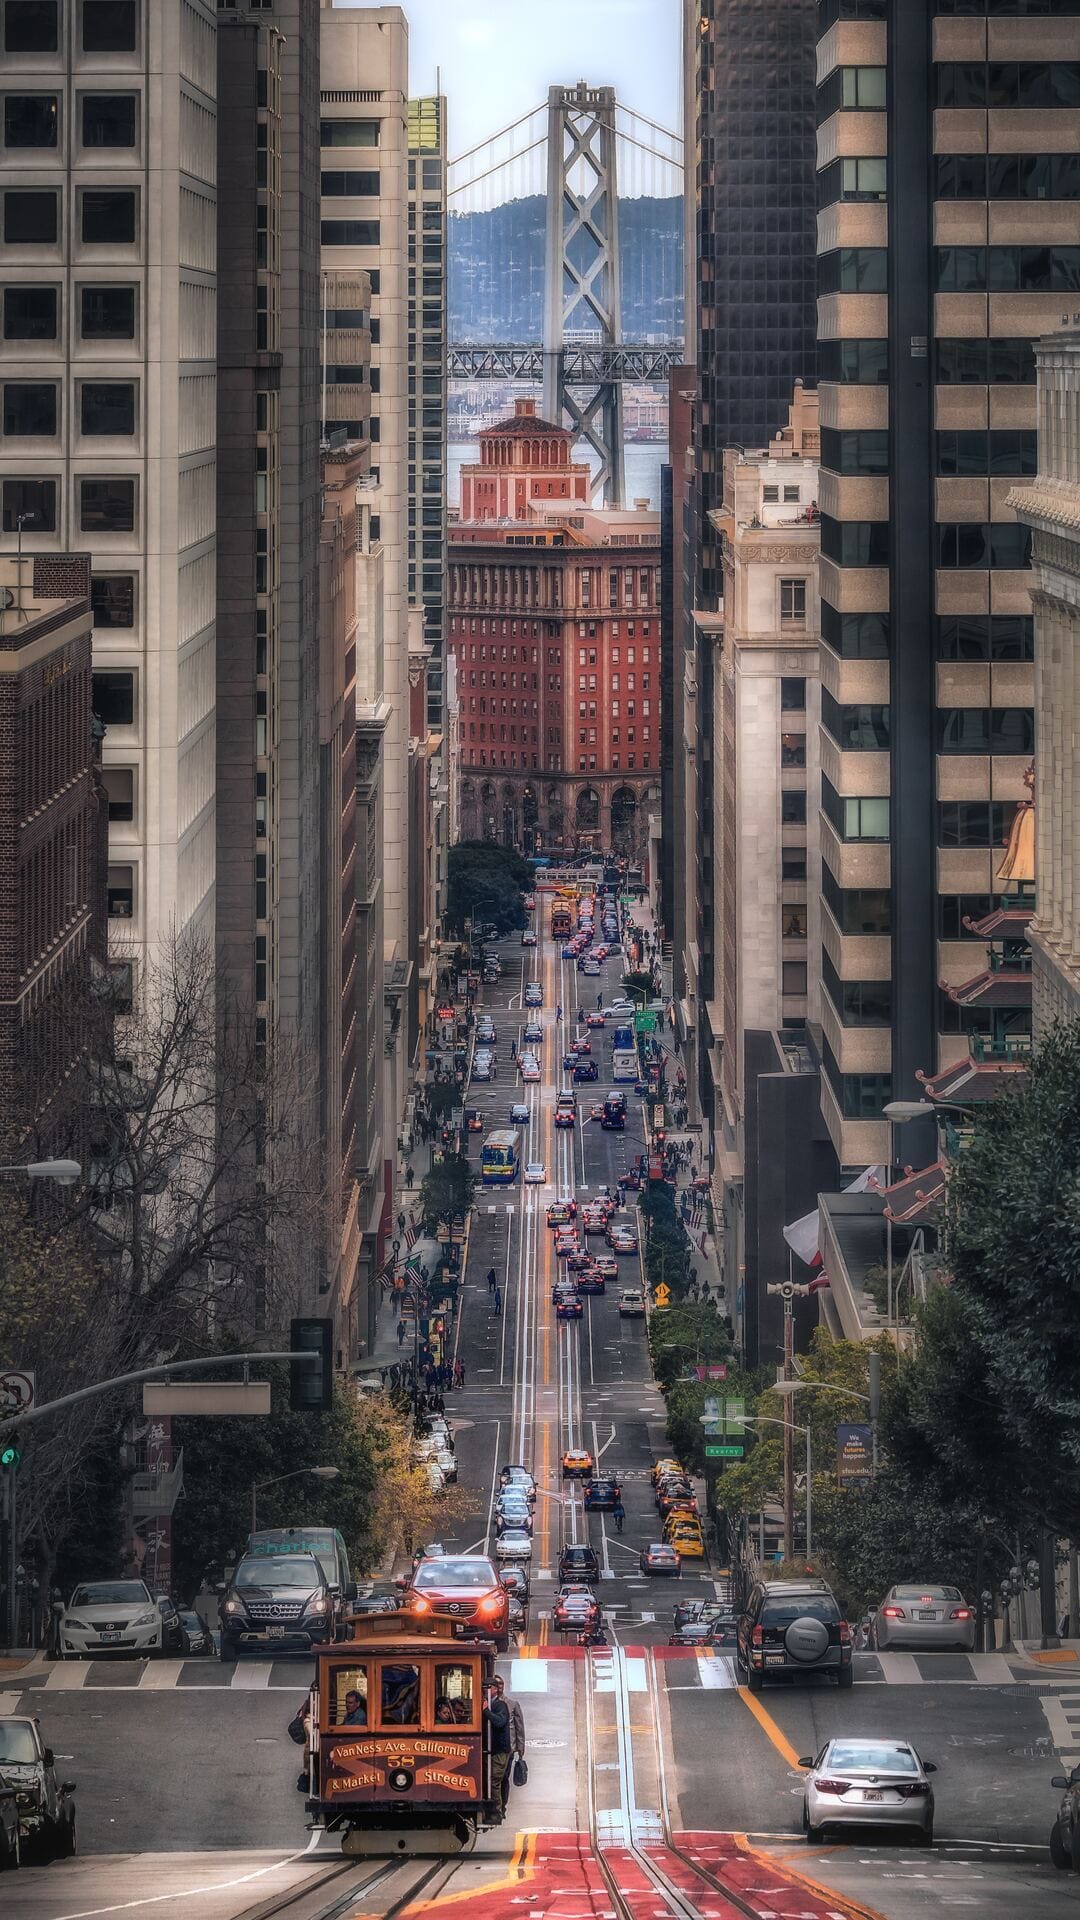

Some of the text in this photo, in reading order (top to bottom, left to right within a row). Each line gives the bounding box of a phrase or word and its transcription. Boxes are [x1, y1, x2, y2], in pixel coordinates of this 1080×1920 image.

[254, 1541, 331, 1553] chariot
[336, 1747, 355, 1758] Van
[355, 1743, 382, 1754] Ness
[414, 1741, 467, 1757] California
[387, 1755, 415, 1768] 58
[332, 1771, 469, 1790] & Market Streets
